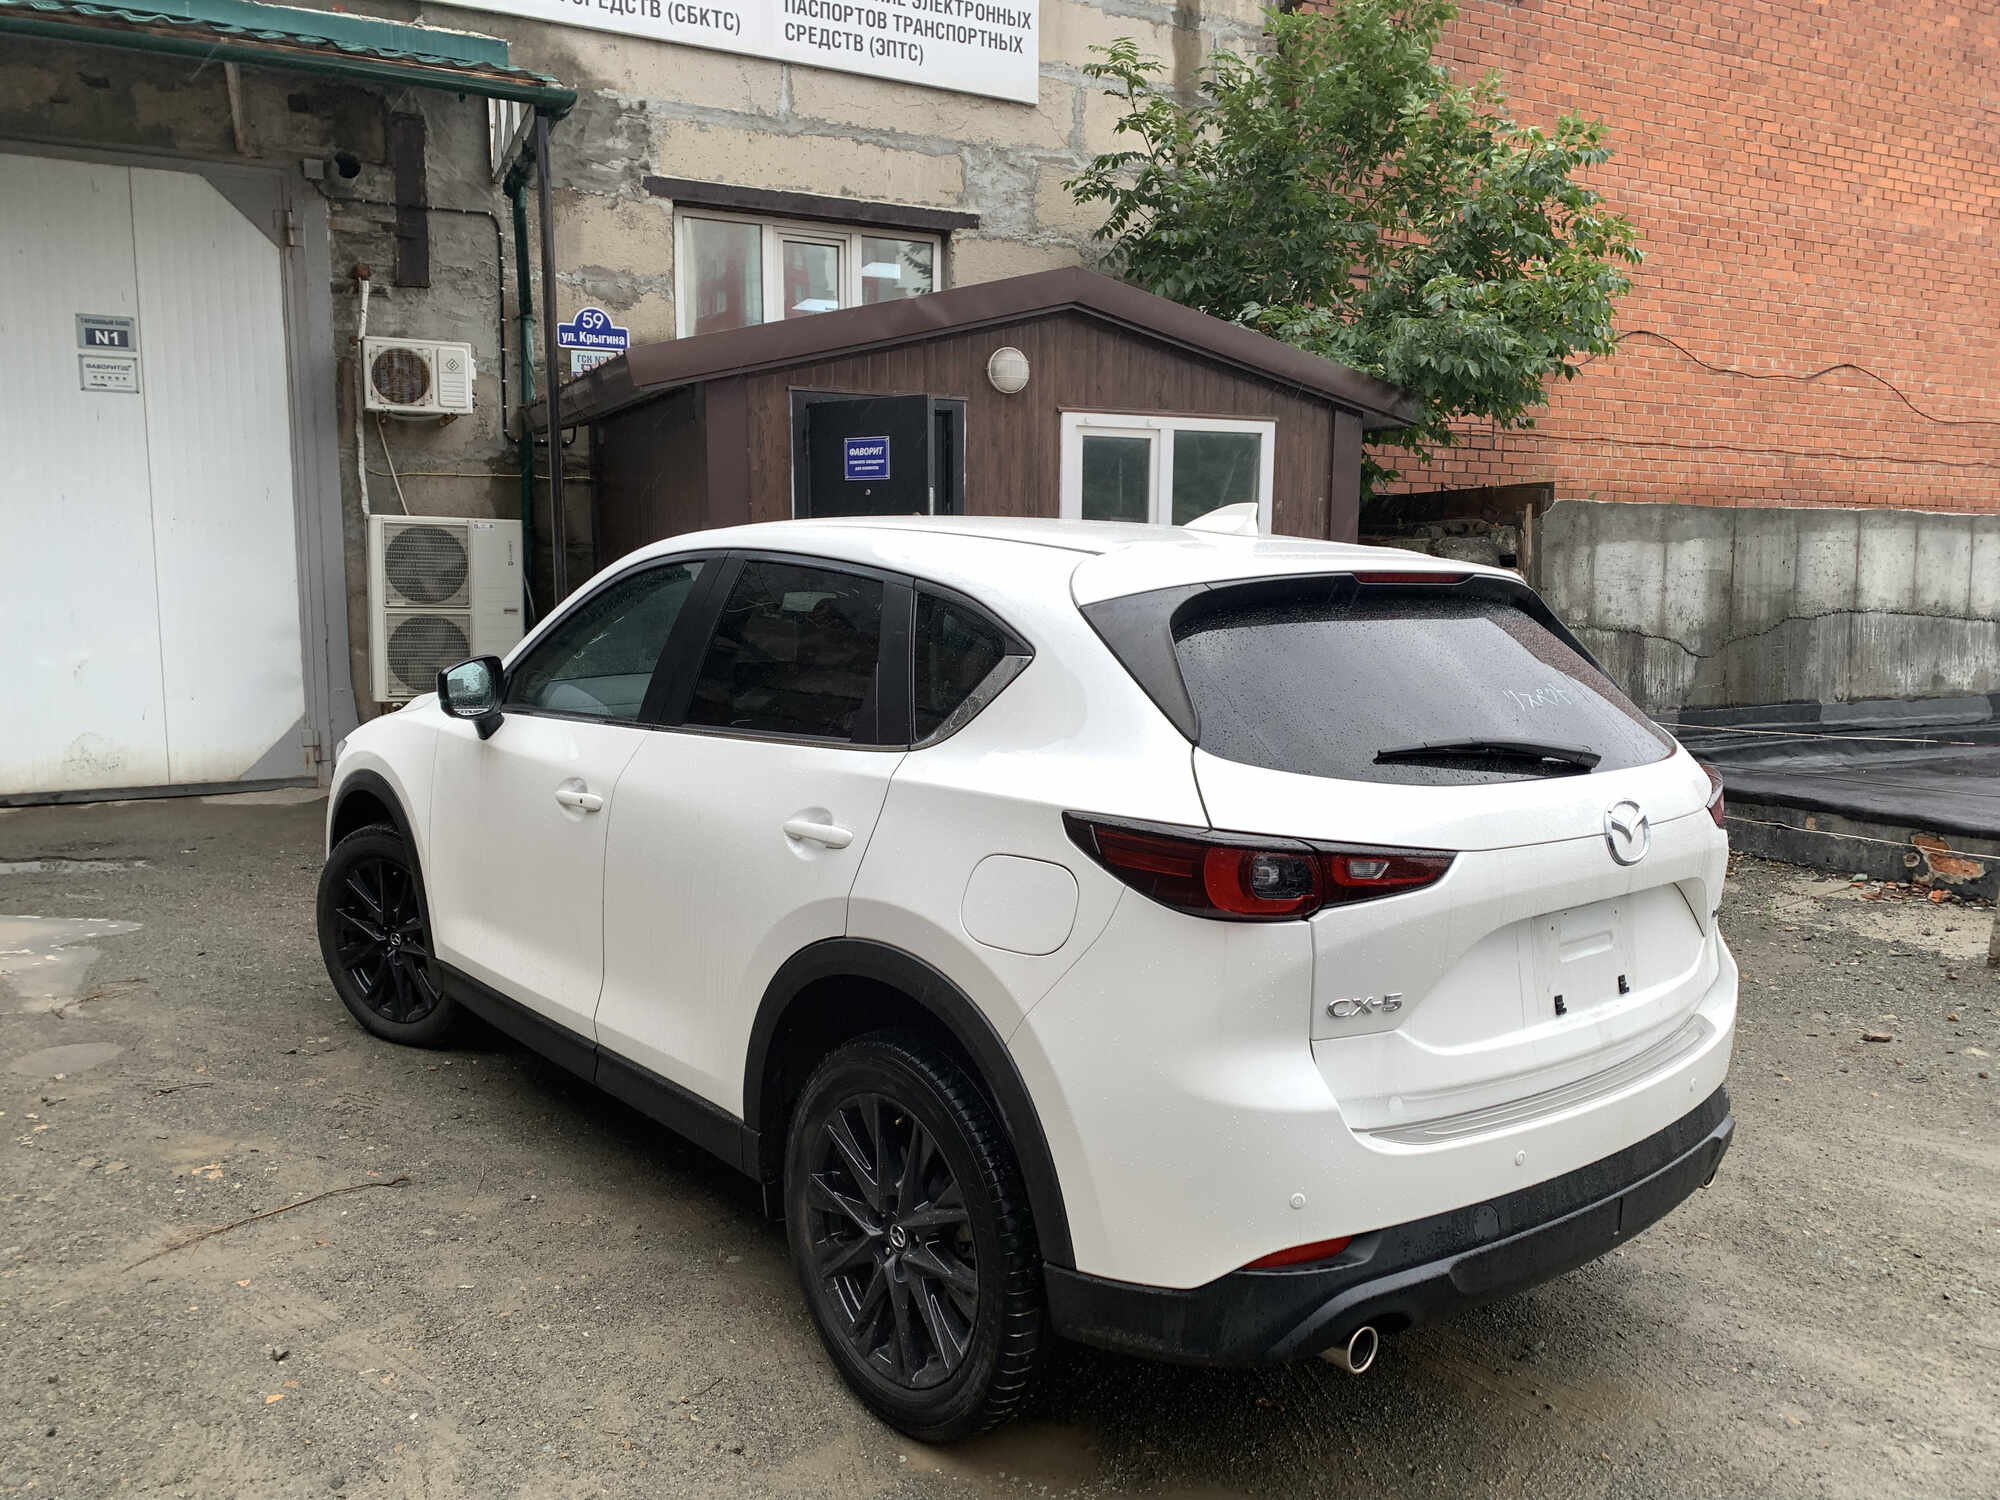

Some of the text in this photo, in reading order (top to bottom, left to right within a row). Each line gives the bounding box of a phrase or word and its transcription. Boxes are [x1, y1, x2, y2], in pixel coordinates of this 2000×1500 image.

[668, 2, 741, 36] (СБКТС)
[785, 0, 1024, 54] ПАСПОРТОВ ТРАНСПОРТНЫХ
[785, 22, 924, 66] СРЕДСТВ (ЭПТС)
[582, 312, 604, 329] 59
[95, 330, 119, 345] N1
[562, 331, 626, 345] ул. Крыгина
[849, 446, 884, 456] ФАВОРИТ
[1326, 992, 1403, 1018] CX-5
